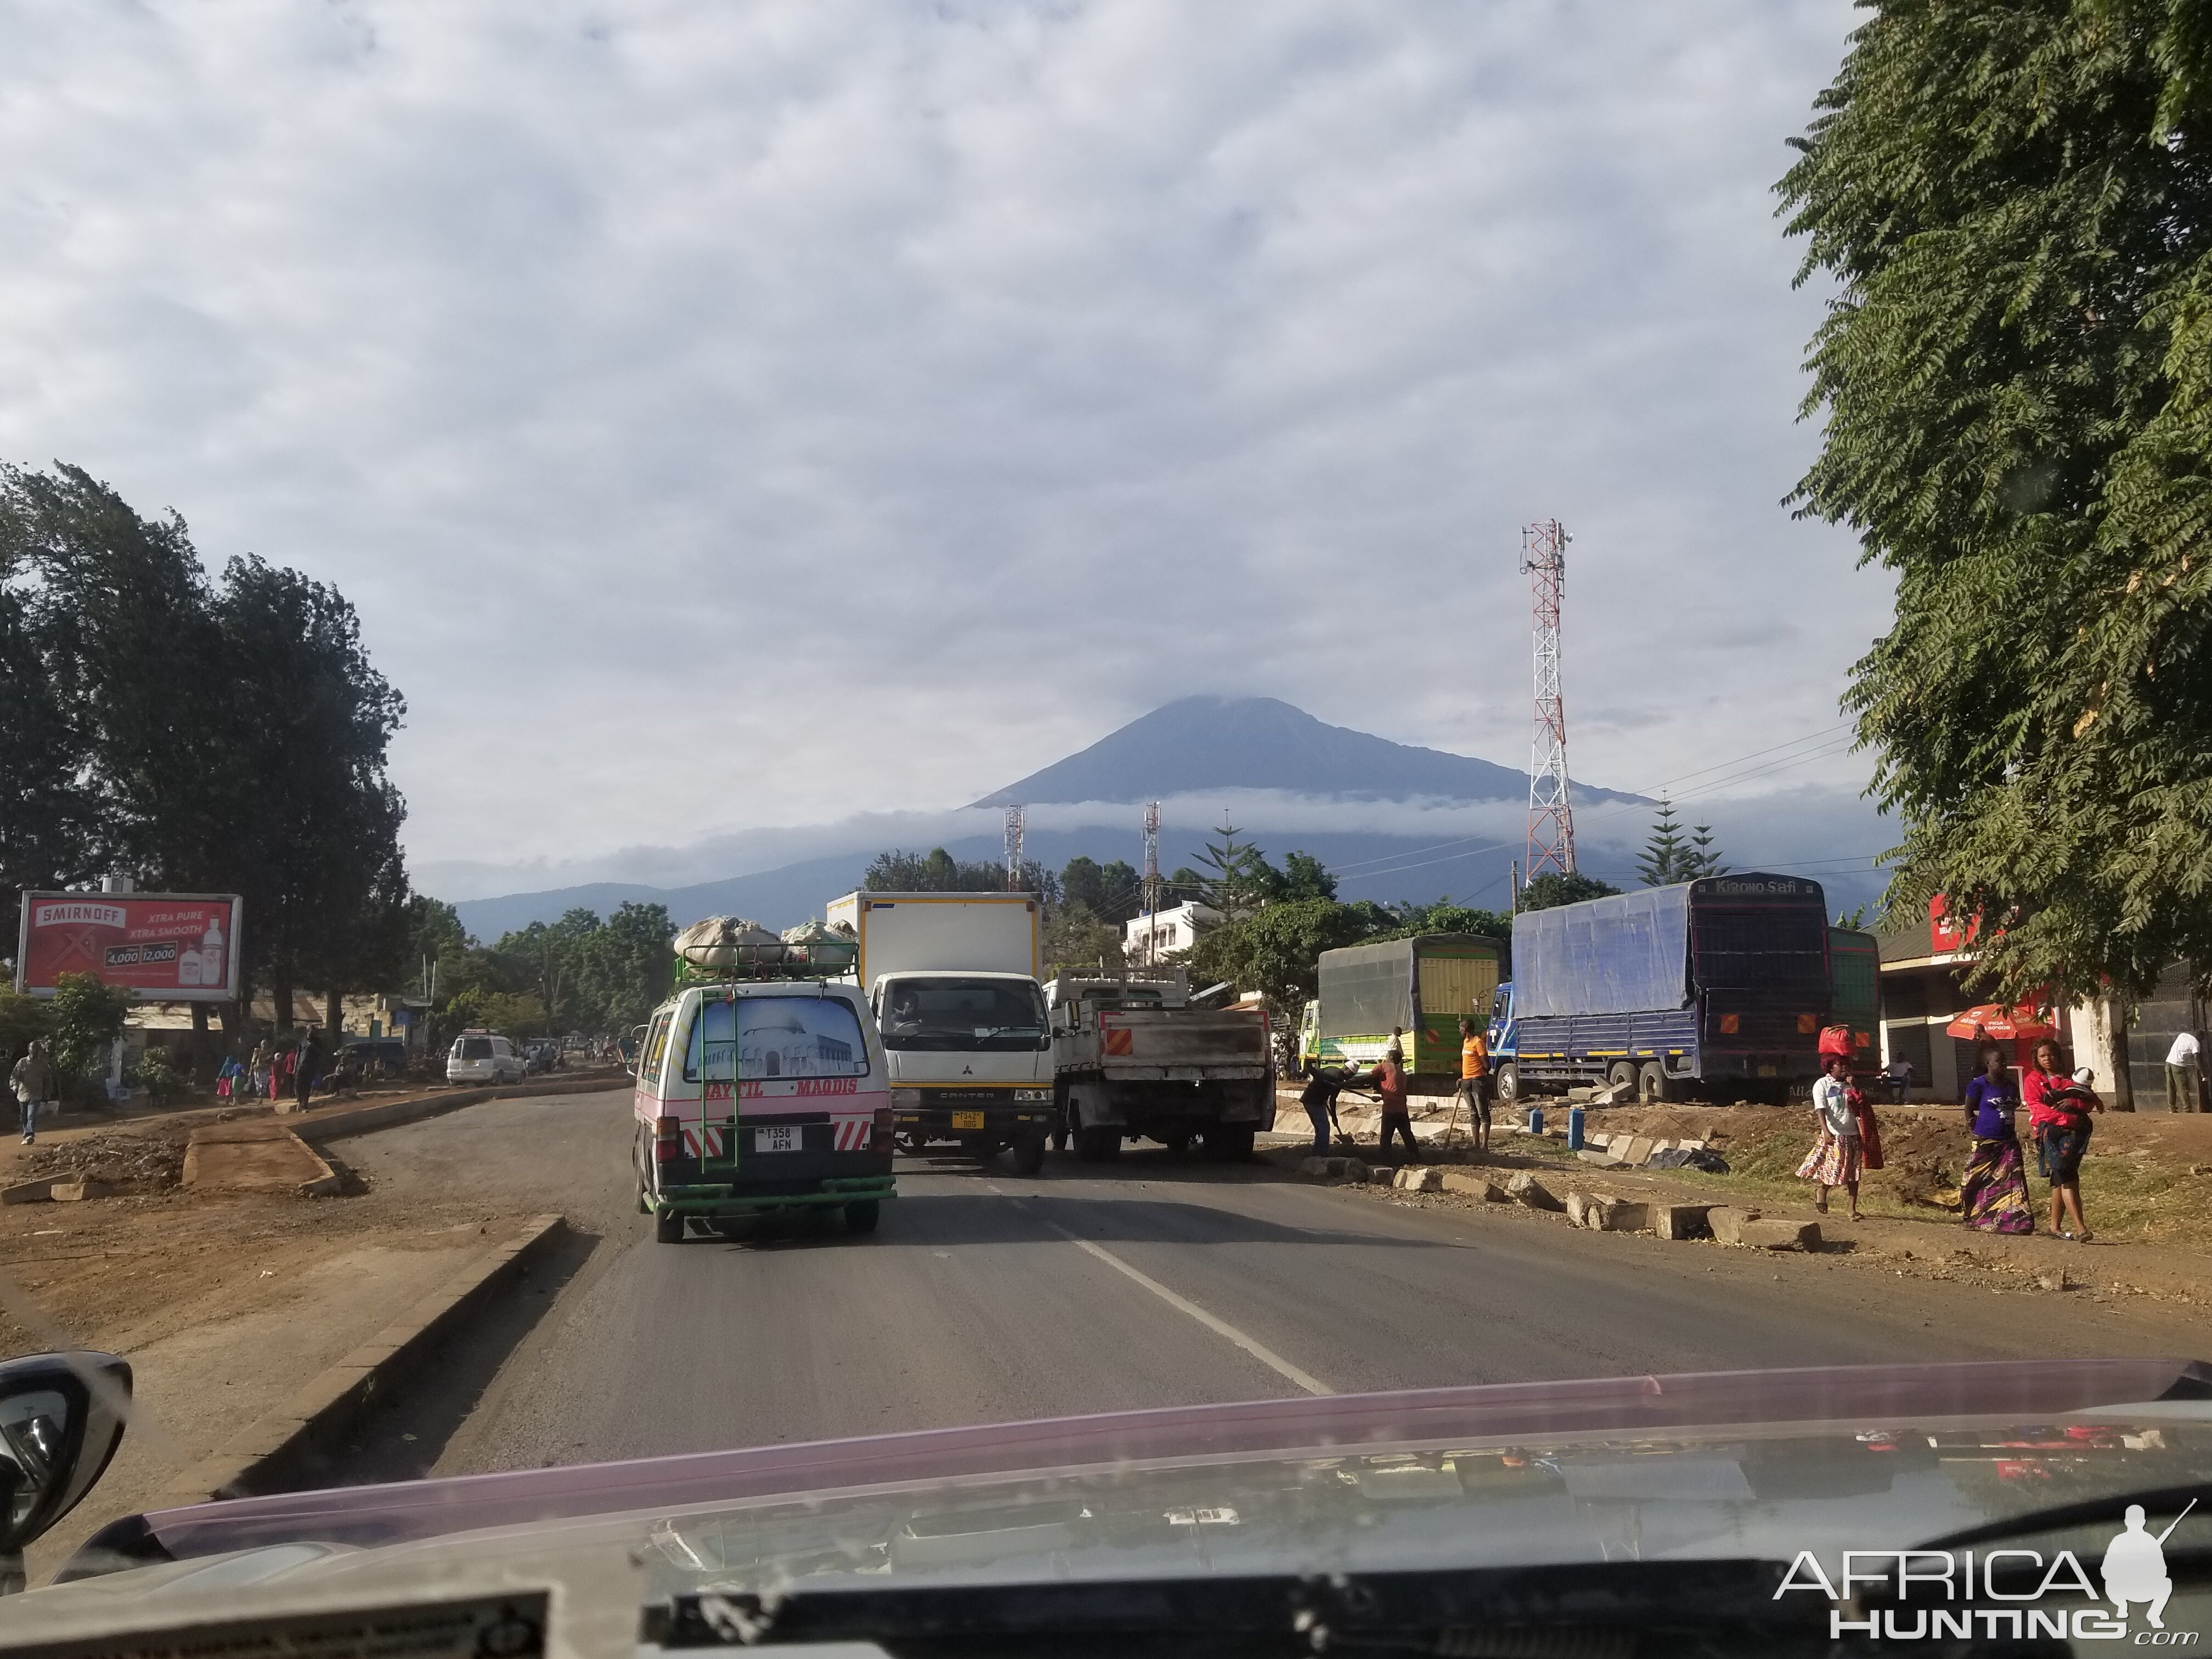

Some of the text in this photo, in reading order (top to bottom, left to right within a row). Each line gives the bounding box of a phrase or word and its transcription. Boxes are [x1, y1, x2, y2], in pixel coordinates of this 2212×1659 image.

[43, 907, 119, 922] SMIRNOFF
[148, 911, 204, 923] XTRA PURE
[129, 924, 202, 939] XTRA SMOOTH
[797, 1078, 858, 1096] MAQDIS
[960, 1112, 976, 1120] T542
[766, 1128, 791, 1138] T358
[772, 1139, 791, 1150] AFN
